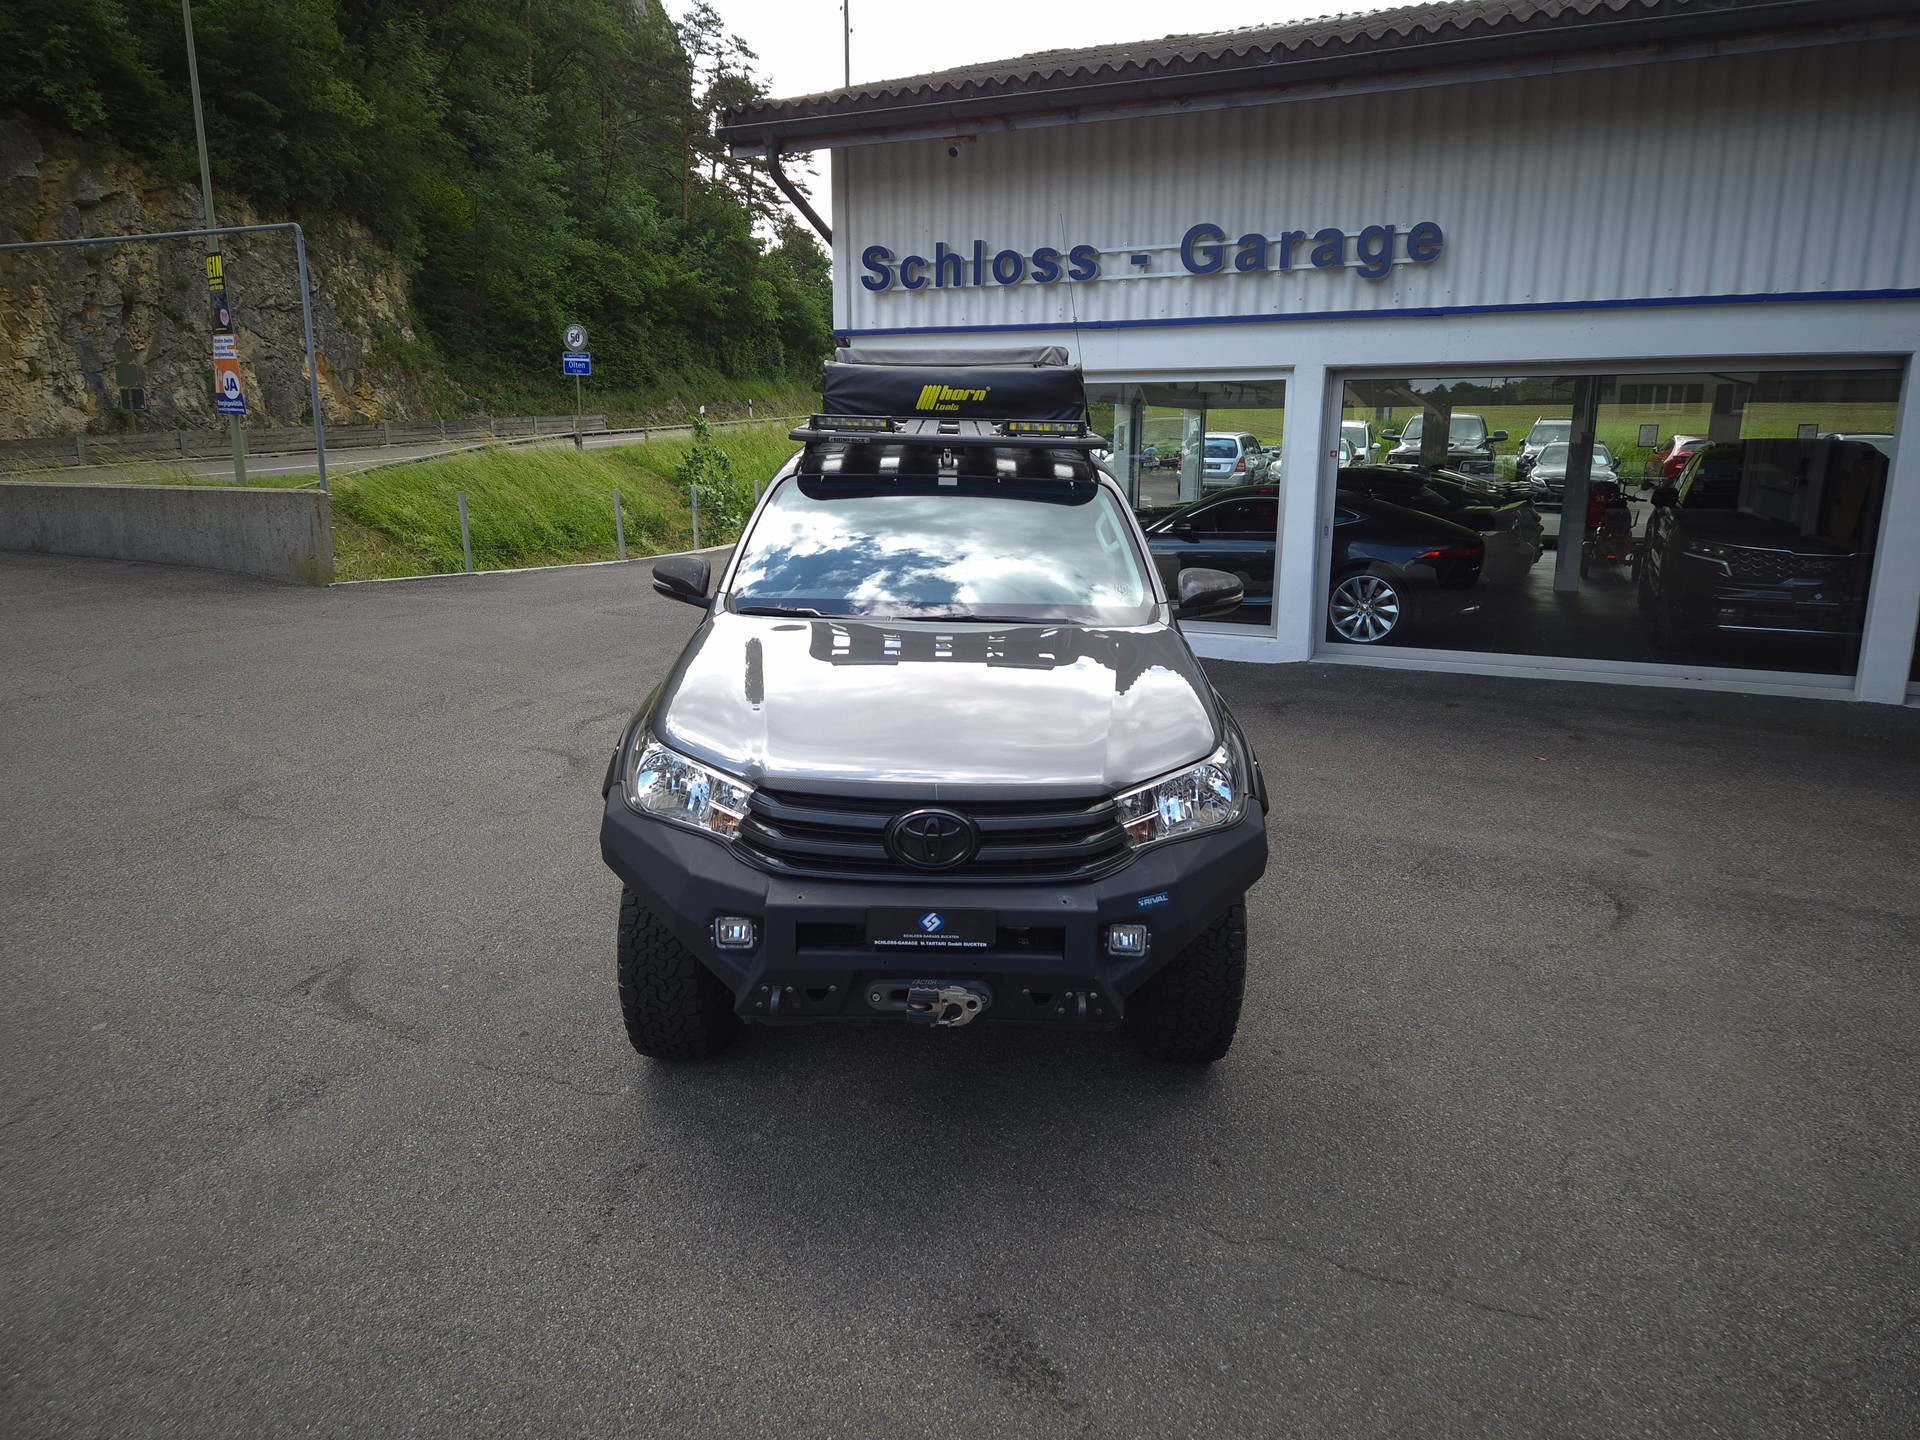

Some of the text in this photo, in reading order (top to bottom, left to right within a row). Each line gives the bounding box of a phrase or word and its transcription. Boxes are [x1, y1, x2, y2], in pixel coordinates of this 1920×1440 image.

[860, 238, 1100, 292] Schloss
[1180, 221, 1445, 279] Garage
[570, 332, 580, 344] 50
[224, 377, 239, 392] JA
[935, 403, 959, 411] tools
[1144, 894, 1169, 906] RIVAL
